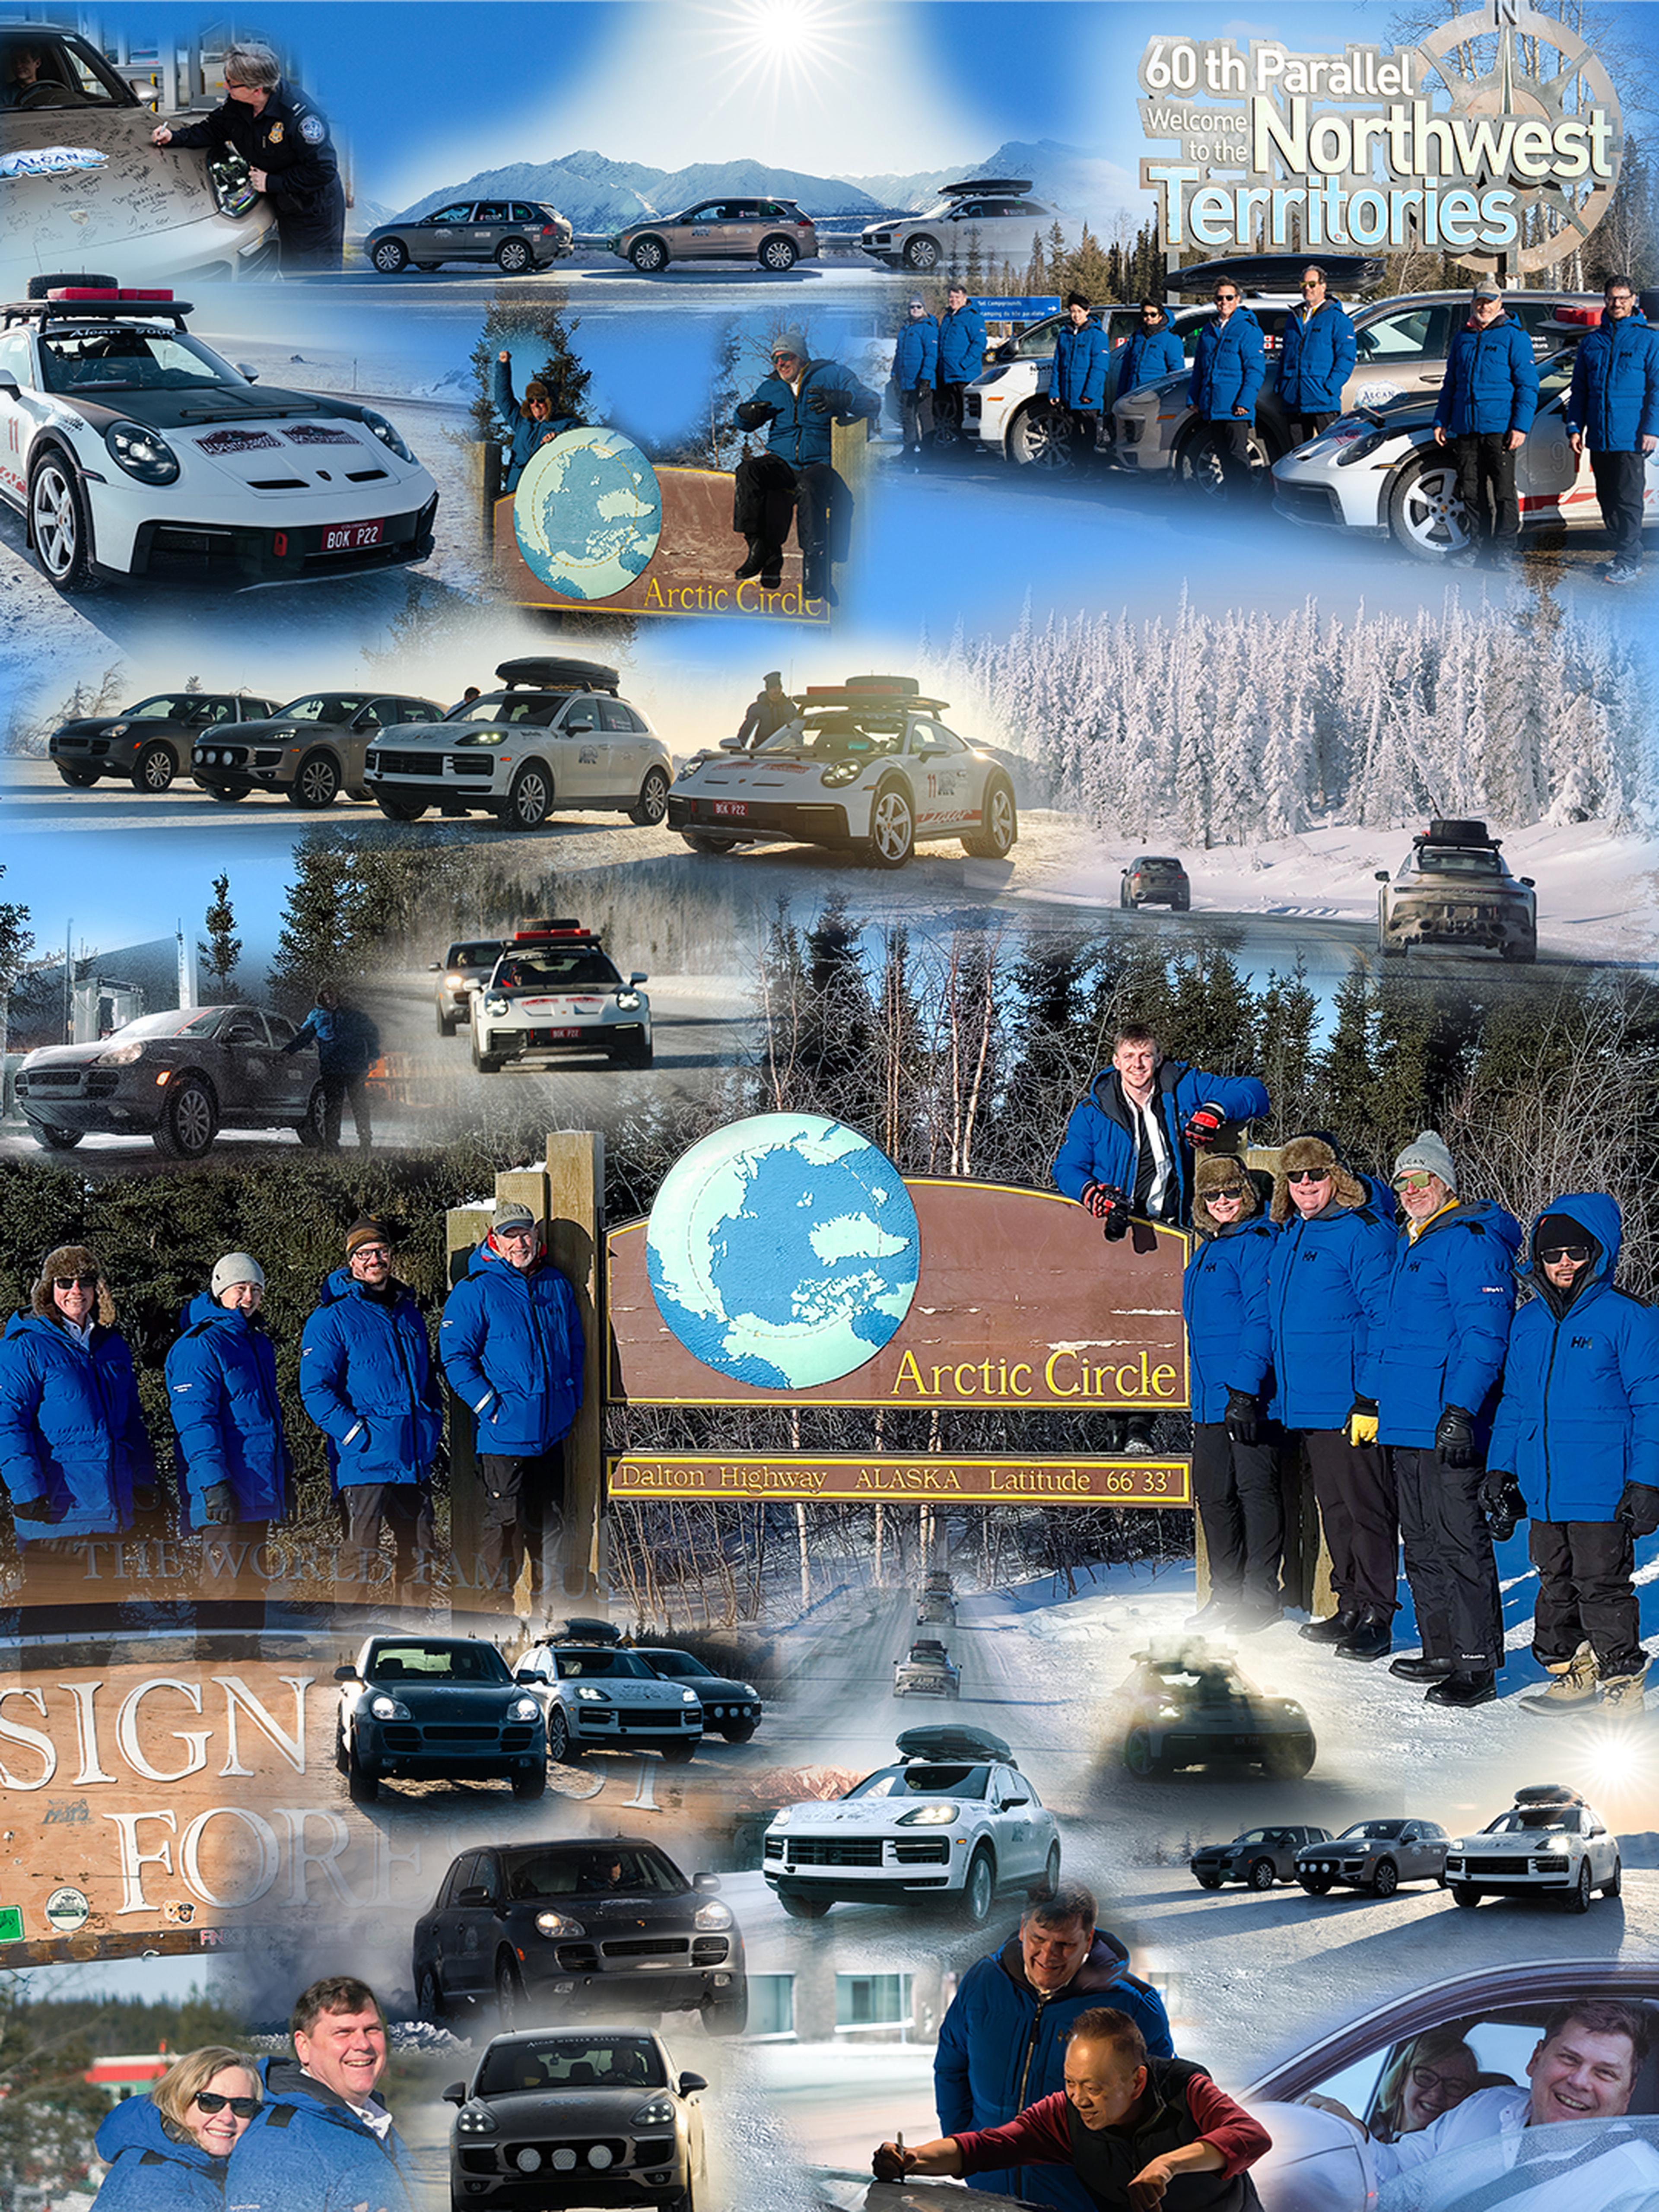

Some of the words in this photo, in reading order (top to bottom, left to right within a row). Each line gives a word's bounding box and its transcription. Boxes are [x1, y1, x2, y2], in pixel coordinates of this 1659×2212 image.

[1145, 44, 1195, 90] 60
[1205, 46, 1246, 91] th
[1256, 48, 1414, 96] Parallel
[1147, 107, 1247, 133] Welcome
[1252, 96, 1613, 178] Northwest
[1189, 139, 1210, 161] to
[1214, 141, 1248, 162] the
[1149, 166, 1518, 246] Territories
[356, 526, 378, 545] P22
[644, 578, 728, 611] Arctic
[736, 580, 821, 616] Circle
[927, 774, 936, 798] 11
[890, 1349, 1033, 1397] Arctic
[1045, 1350, 1177, 1397] Circle
[621, 1465, 706, 1487] Dalton
[719, 1466, 827, 1495] Highway
[854, 1468, 961, 1490] ALASKA
[989, 1469, 1091, 1492] Latitude
[72, 1539, 186, 1580] THE
[0, 1677, 316, 1791] SIGN
